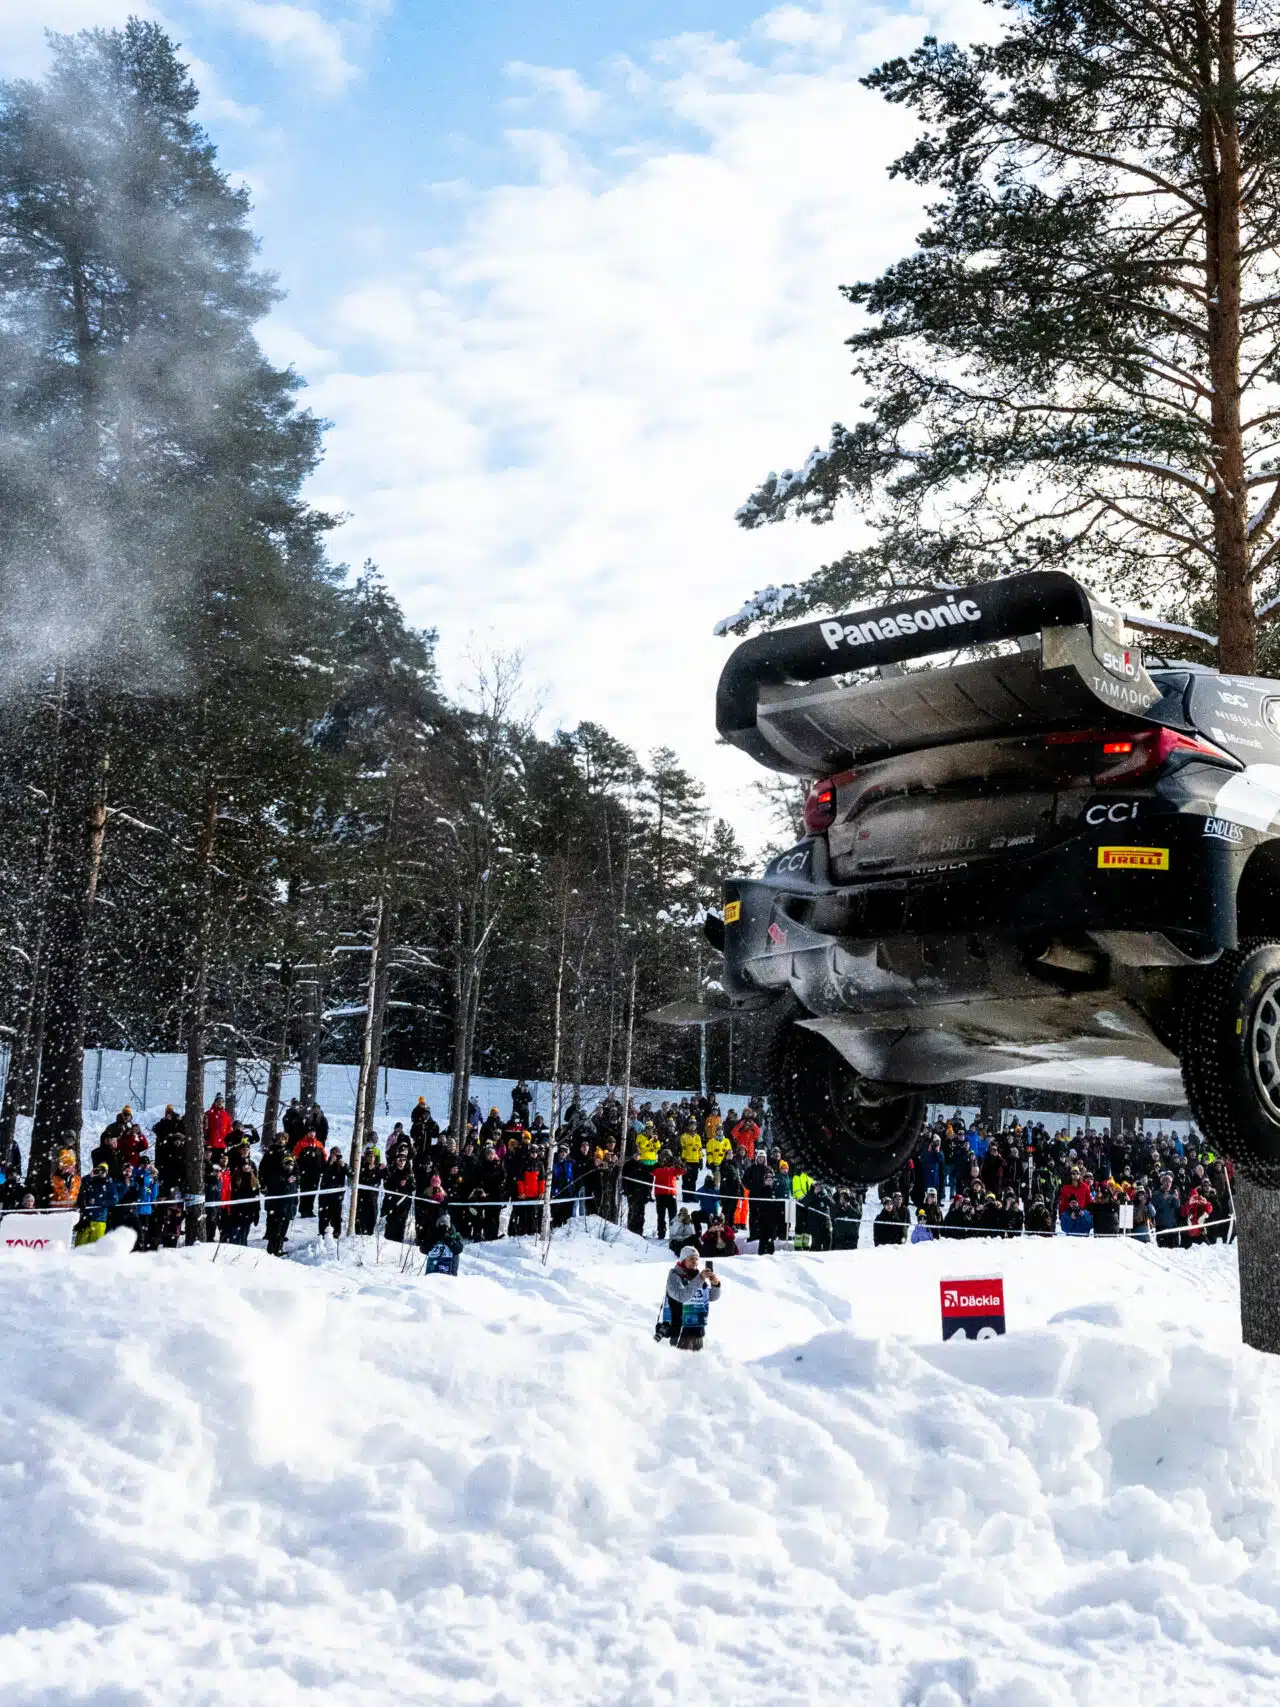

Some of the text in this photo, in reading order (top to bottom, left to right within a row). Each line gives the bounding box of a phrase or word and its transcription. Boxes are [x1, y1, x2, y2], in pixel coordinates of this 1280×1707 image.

[820, 595, 982, 651] Panasonic
[1092, 676, 1151, 709] TAMADIC
[1203, 817, 1244, 842] ENDLESS
[1103, 850, 1163, 866] PIRELLI
[960, 1295, 1000, 1307] Däckia
